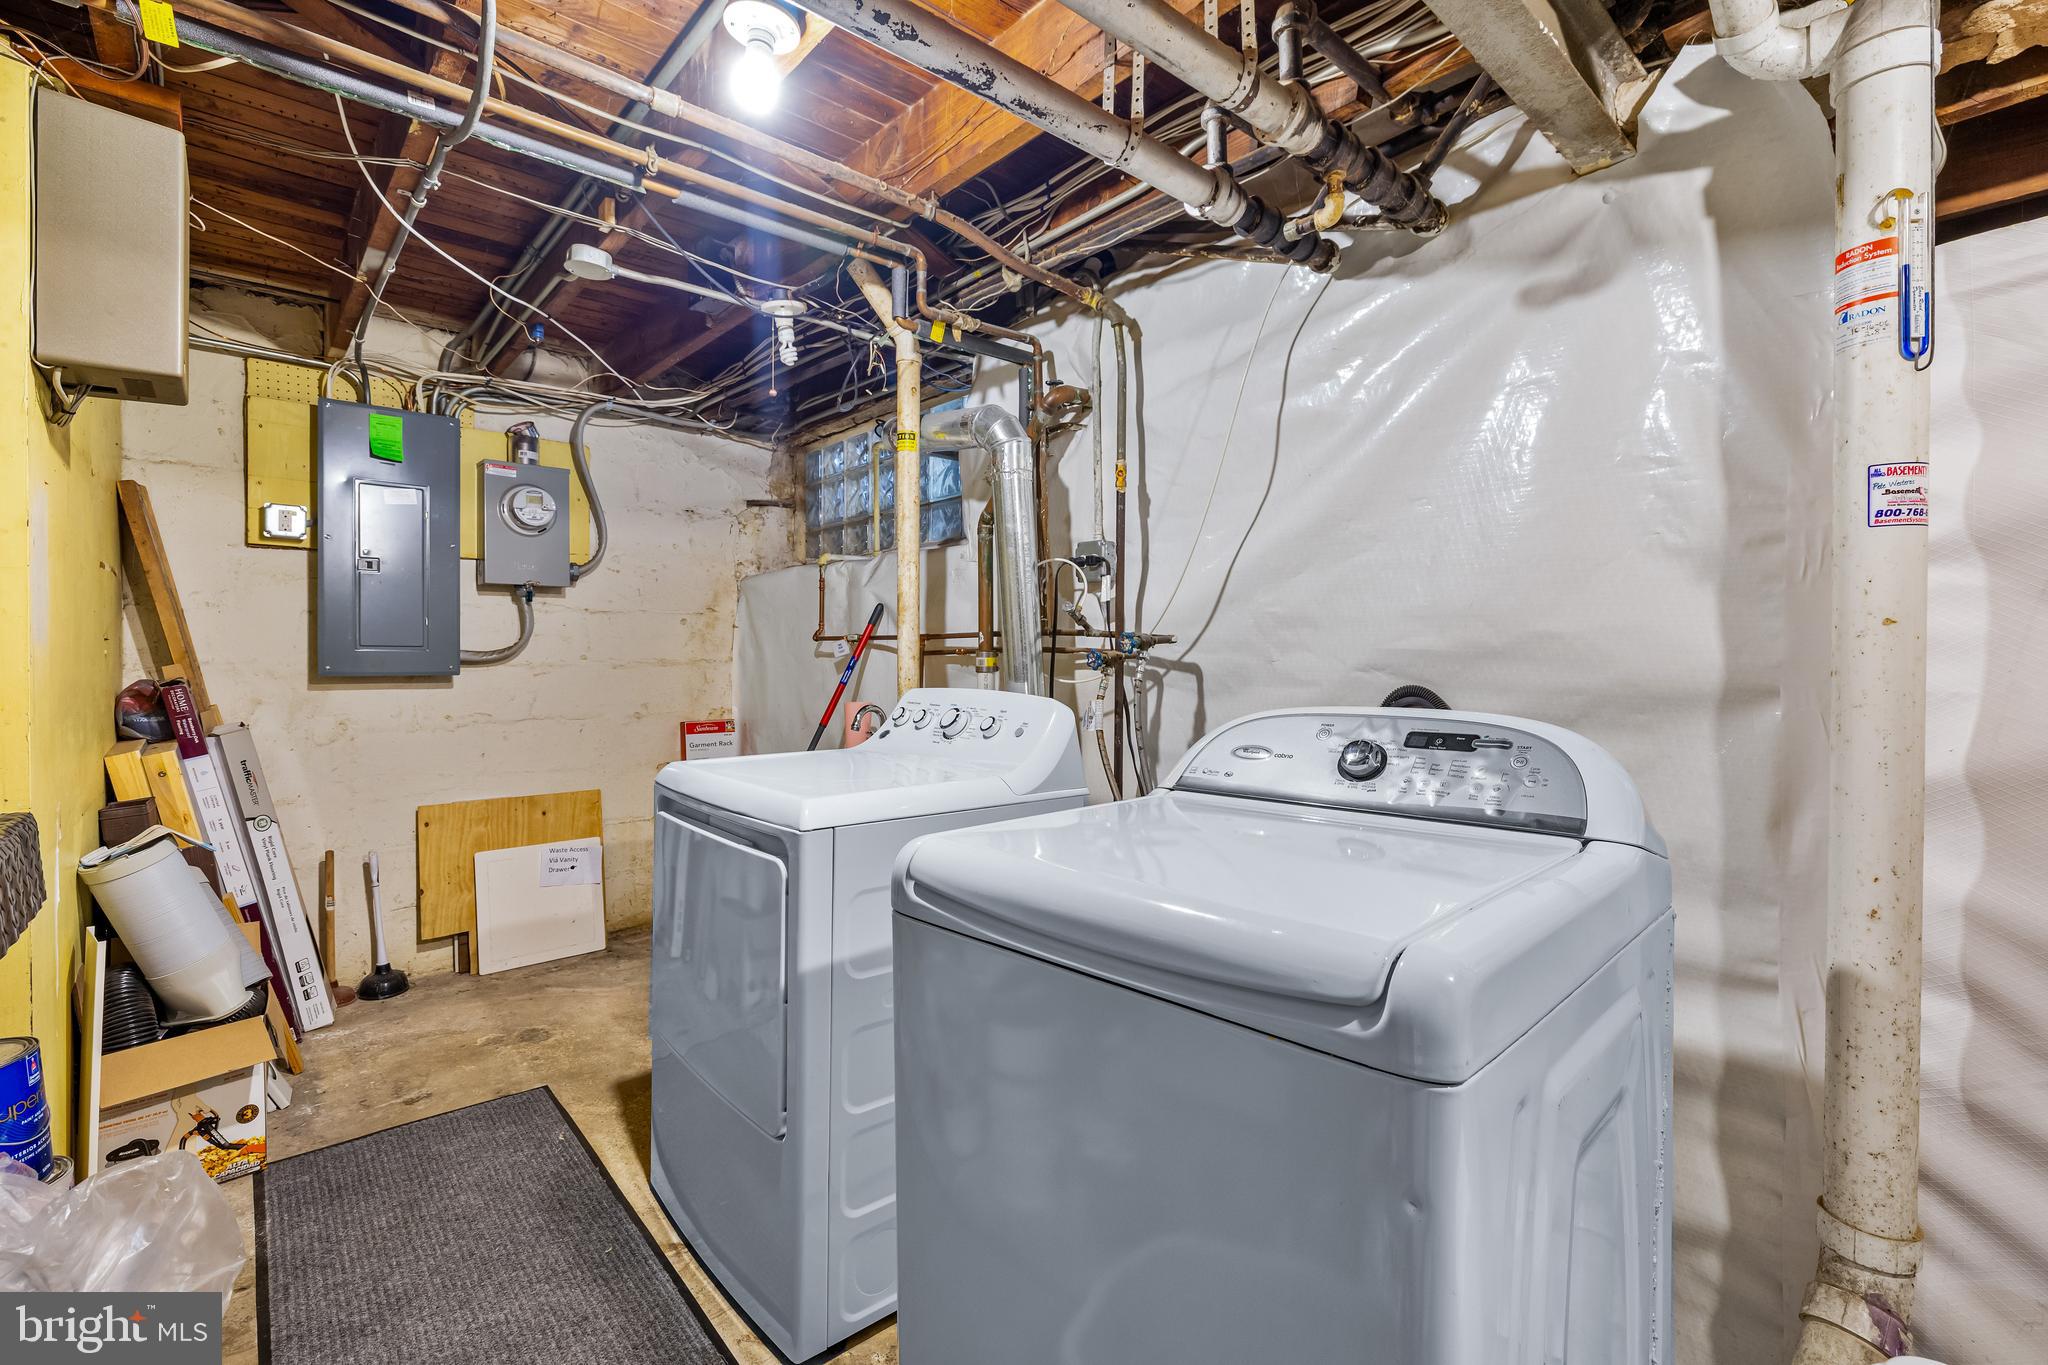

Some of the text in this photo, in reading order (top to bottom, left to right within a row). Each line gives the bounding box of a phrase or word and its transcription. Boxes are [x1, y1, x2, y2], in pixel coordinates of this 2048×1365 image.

[1845, 244, 1874, 258] RADON
[1864, 248, 1893, 260] System
[1849, 305, 1887, 321] RADON
[174, 688, 188, 711] HOME
[243, 1109, 253, 1119] 3
[226, 1159, 249, 1172] ALTA
